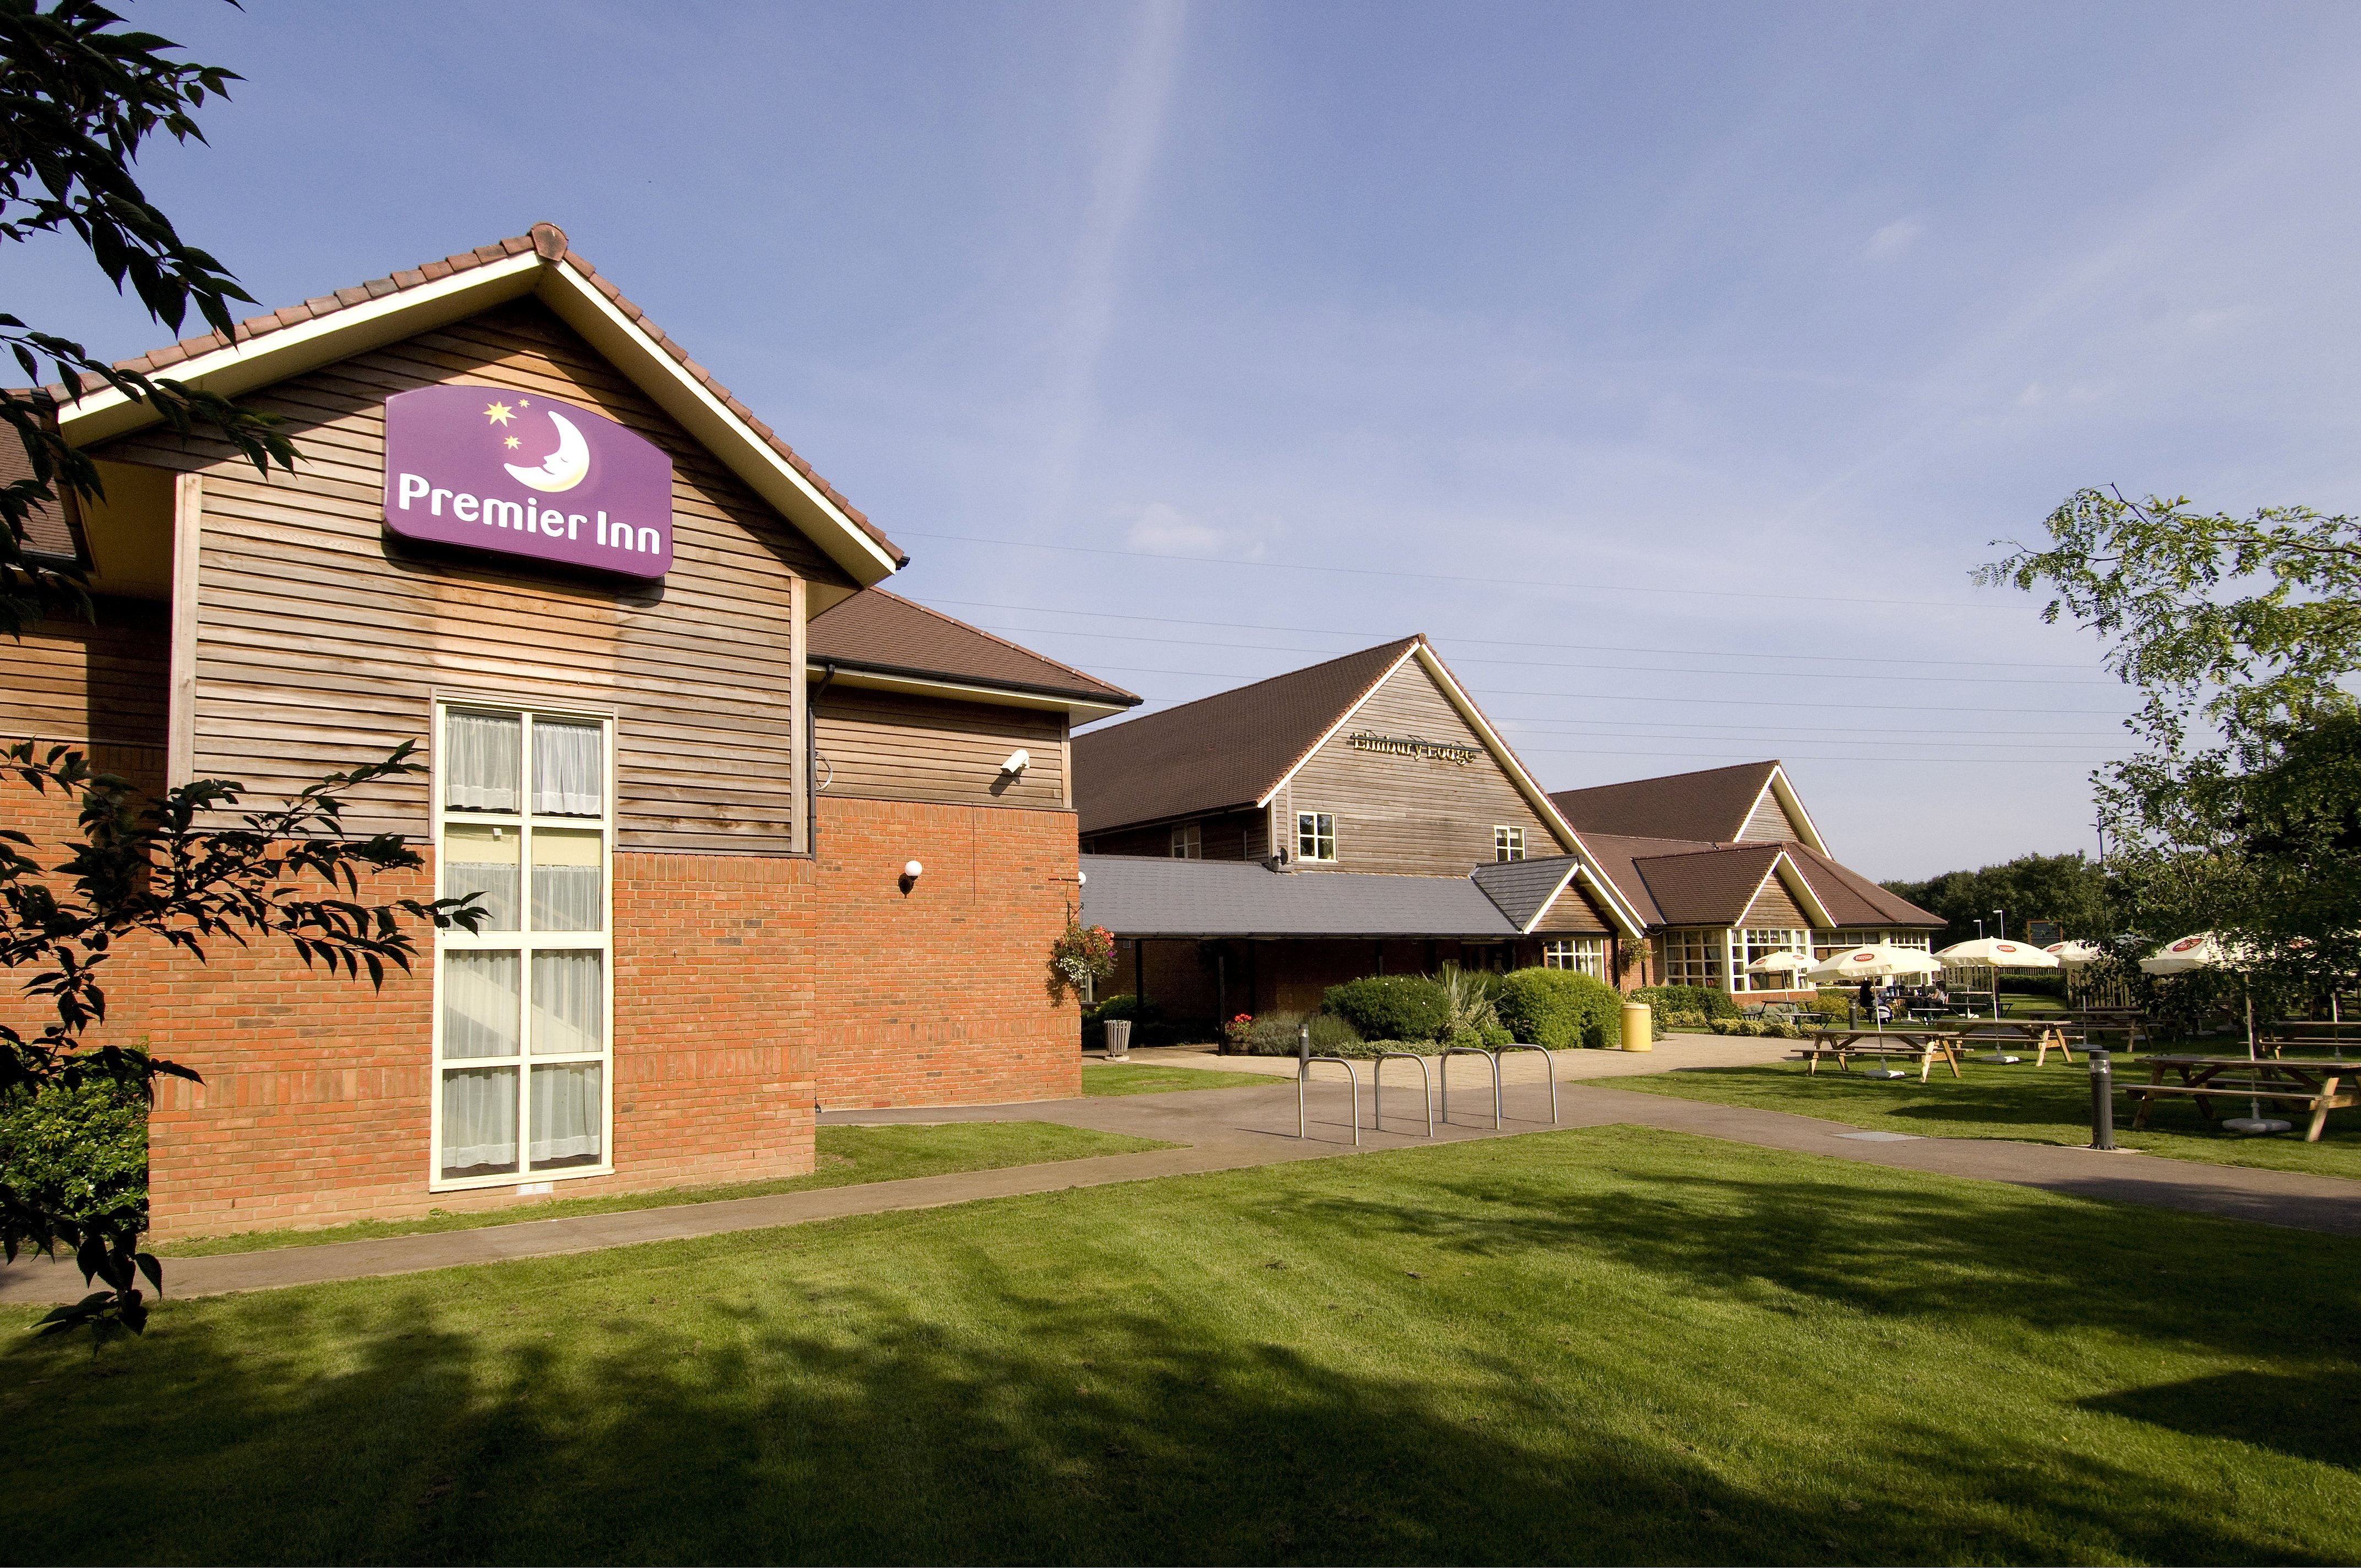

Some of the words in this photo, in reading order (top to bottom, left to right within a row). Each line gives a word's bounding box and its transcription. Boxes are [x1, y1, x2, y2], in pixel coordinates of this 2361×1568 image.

[399, 472, 587, 541] Premier
[596, 510, 660, 556] Inn
[1427, 742, 1475, 766] Lodge
